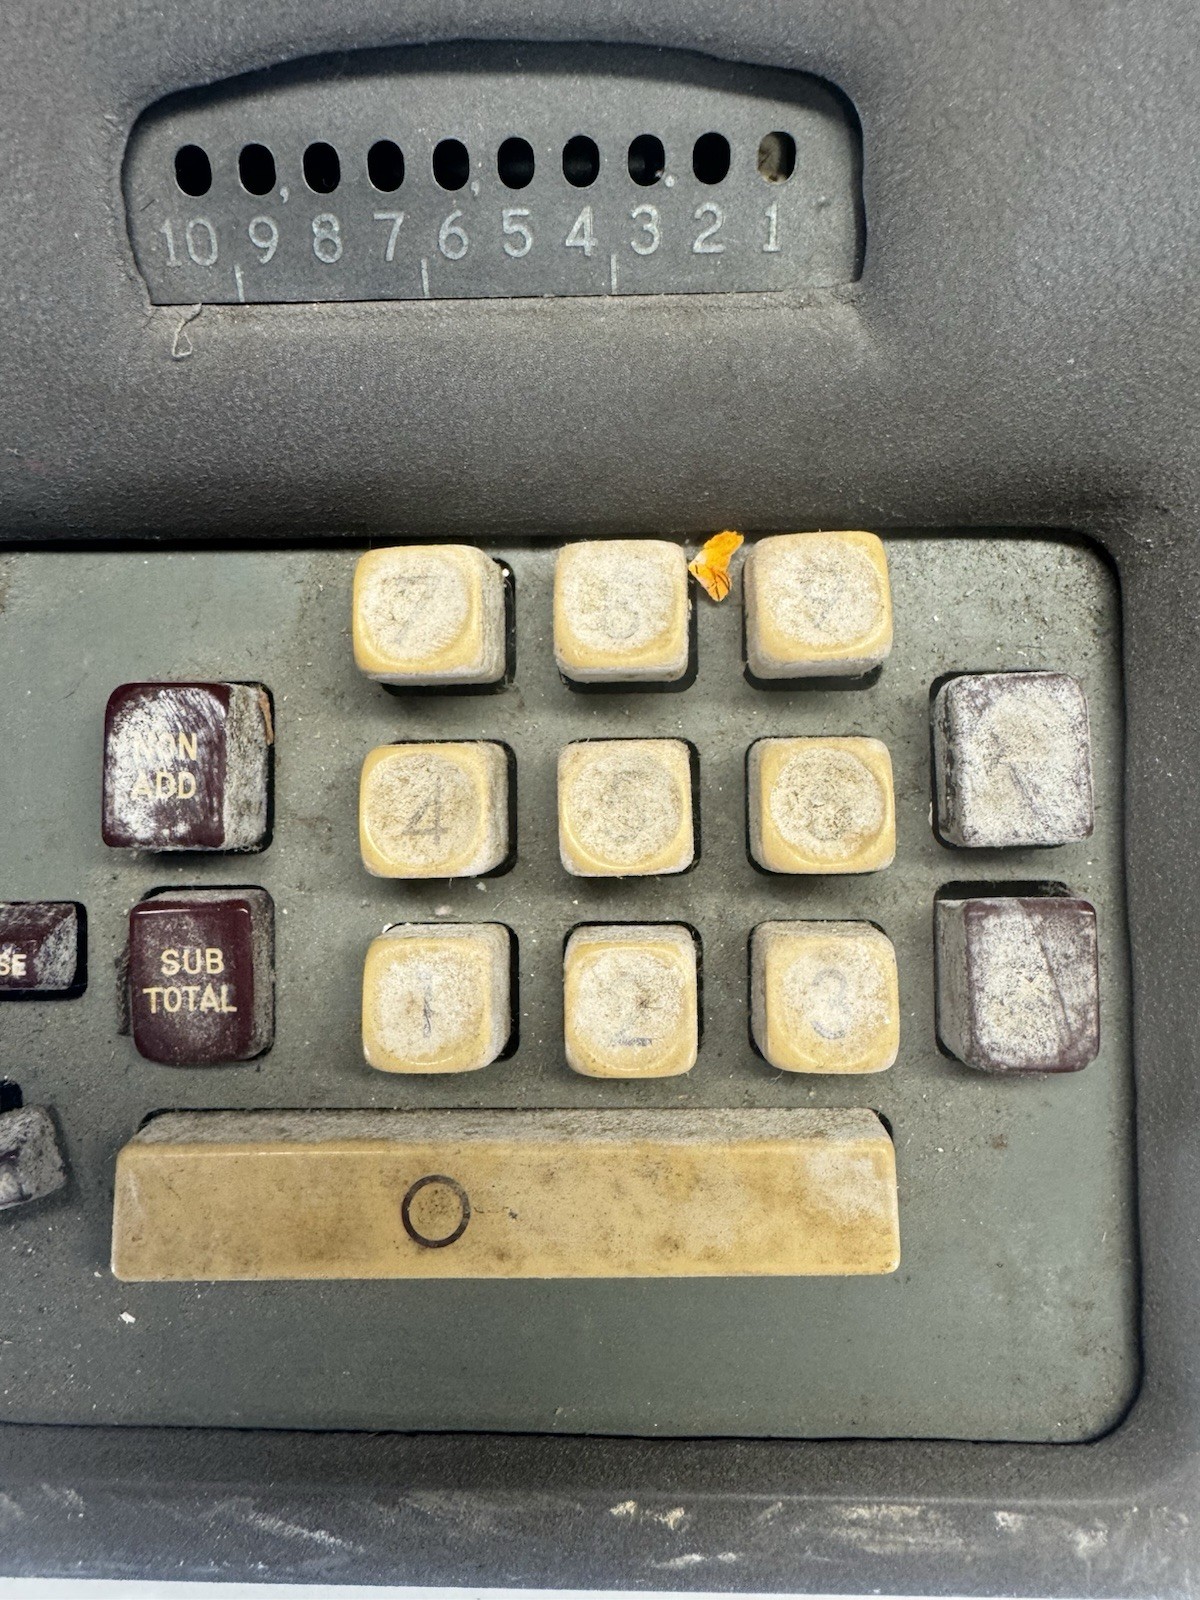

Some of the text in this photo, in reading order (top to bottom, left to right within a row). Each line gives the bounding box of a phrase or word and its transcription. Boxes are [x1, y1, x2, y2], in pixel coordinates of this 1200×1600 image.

[160, 202, 781, 267] 10 9 8 7 6 5 4 3 2 1
[132, 732, 198, 761] NON
[130, 770, 198, 799] ADD
[396, 772, 449, 846] 4
[160, 948, 225, 977] SUB
[142, 985, 238, 1014] TOTAL
